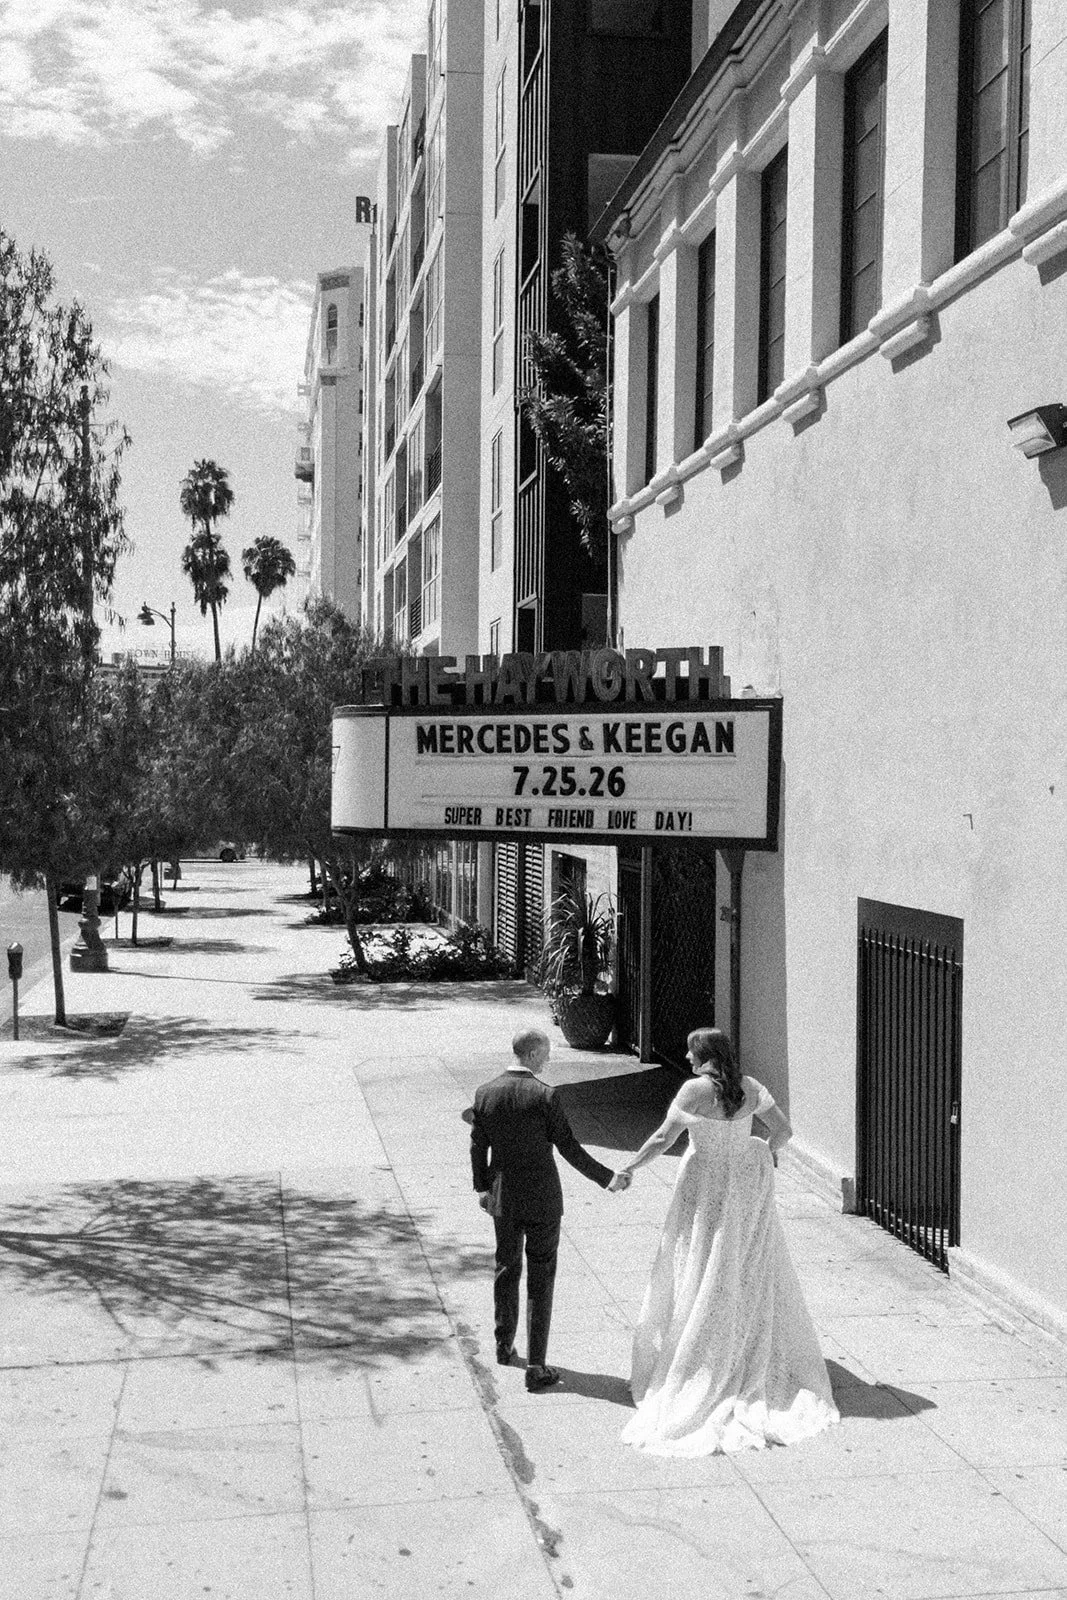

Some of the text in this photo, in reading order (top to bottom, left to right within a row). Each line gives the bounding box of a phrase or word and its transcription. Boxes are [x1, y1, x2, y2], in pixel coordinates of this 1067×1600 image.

[368, 646, 721, 705] THE HAYWORTH
[416, 720, 735, 754] MERCEDES & KEEGAN
[513, 766, 626, 798] 7.25.26
[444, 806, 693, 831] SUPER BEST FRIEND LOVE DAY!
